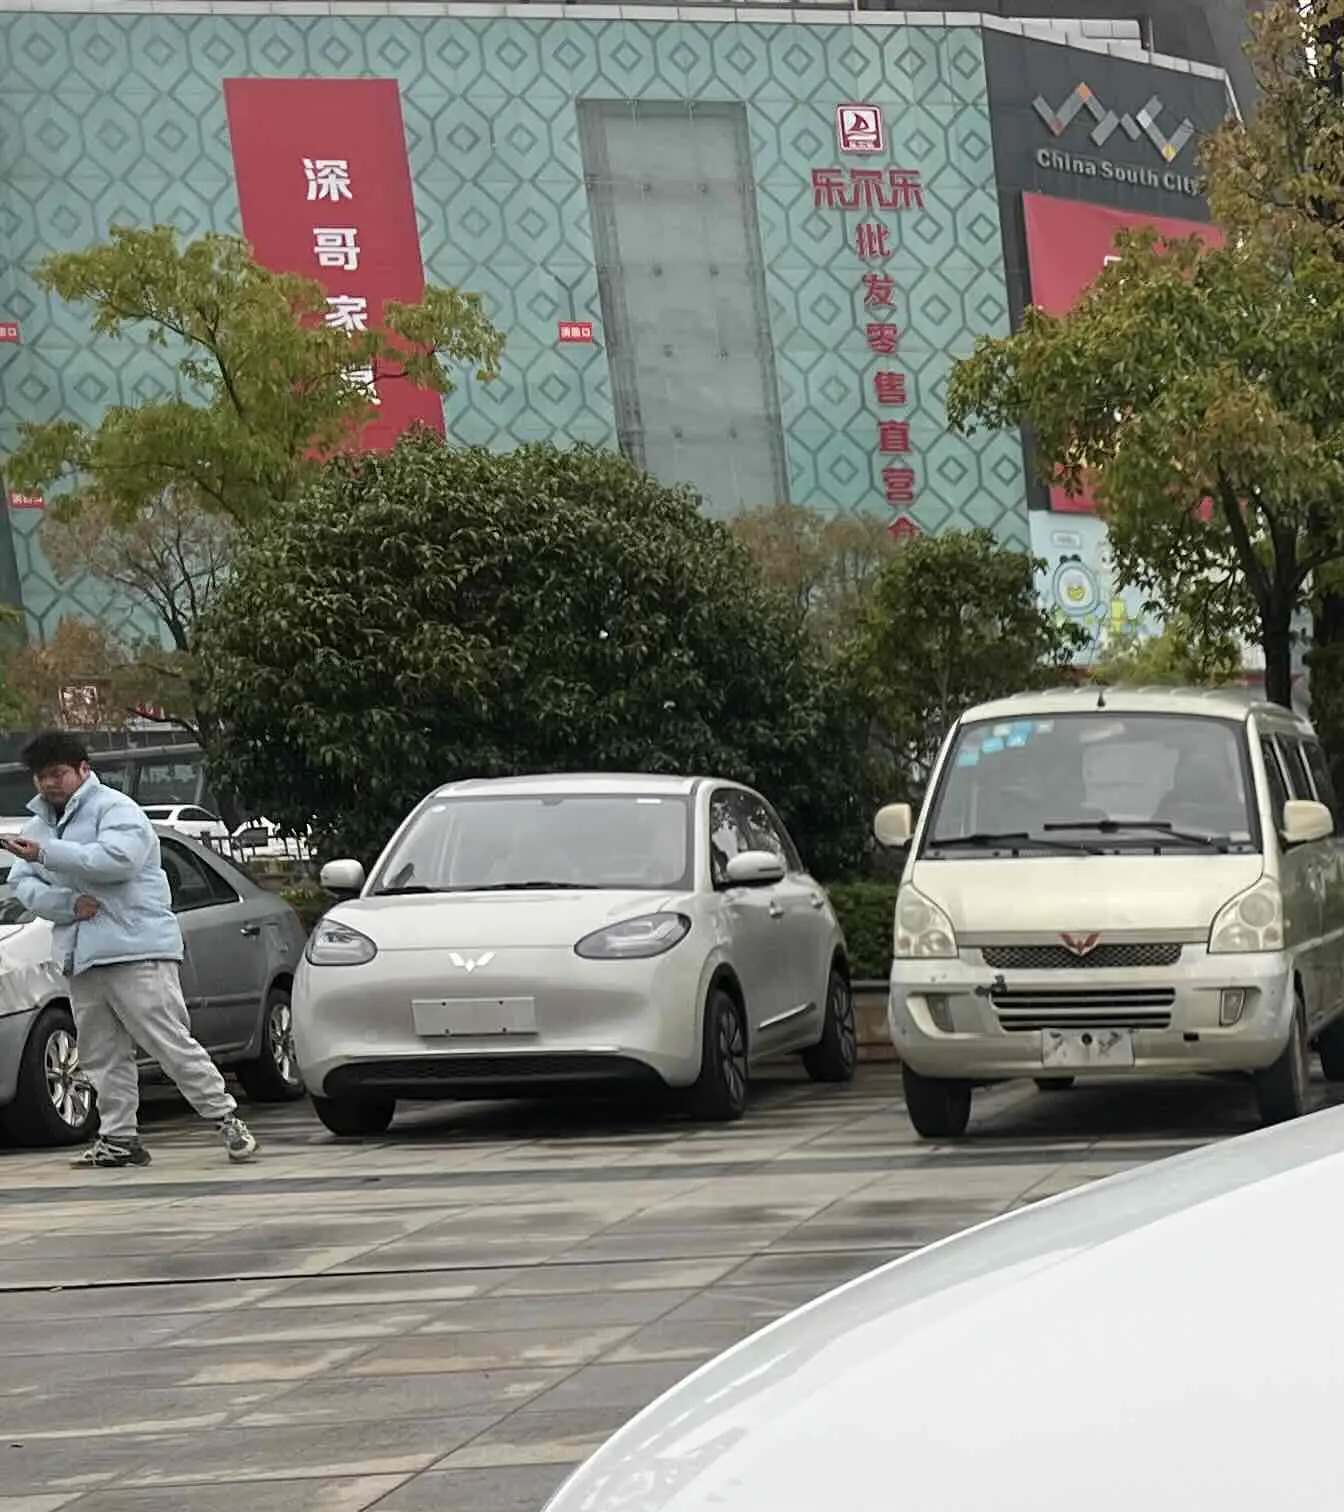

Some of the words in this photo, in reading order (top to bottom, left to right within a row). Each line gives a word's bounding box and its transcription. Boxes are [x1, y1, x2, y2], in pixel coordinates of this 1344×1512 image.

[811, 167, 925, 213] 乐尔乐
[1037, 148, 1097, 178] China
[1100, 160, 1159, 189] South
[1163, 171, 1201, 197] City
